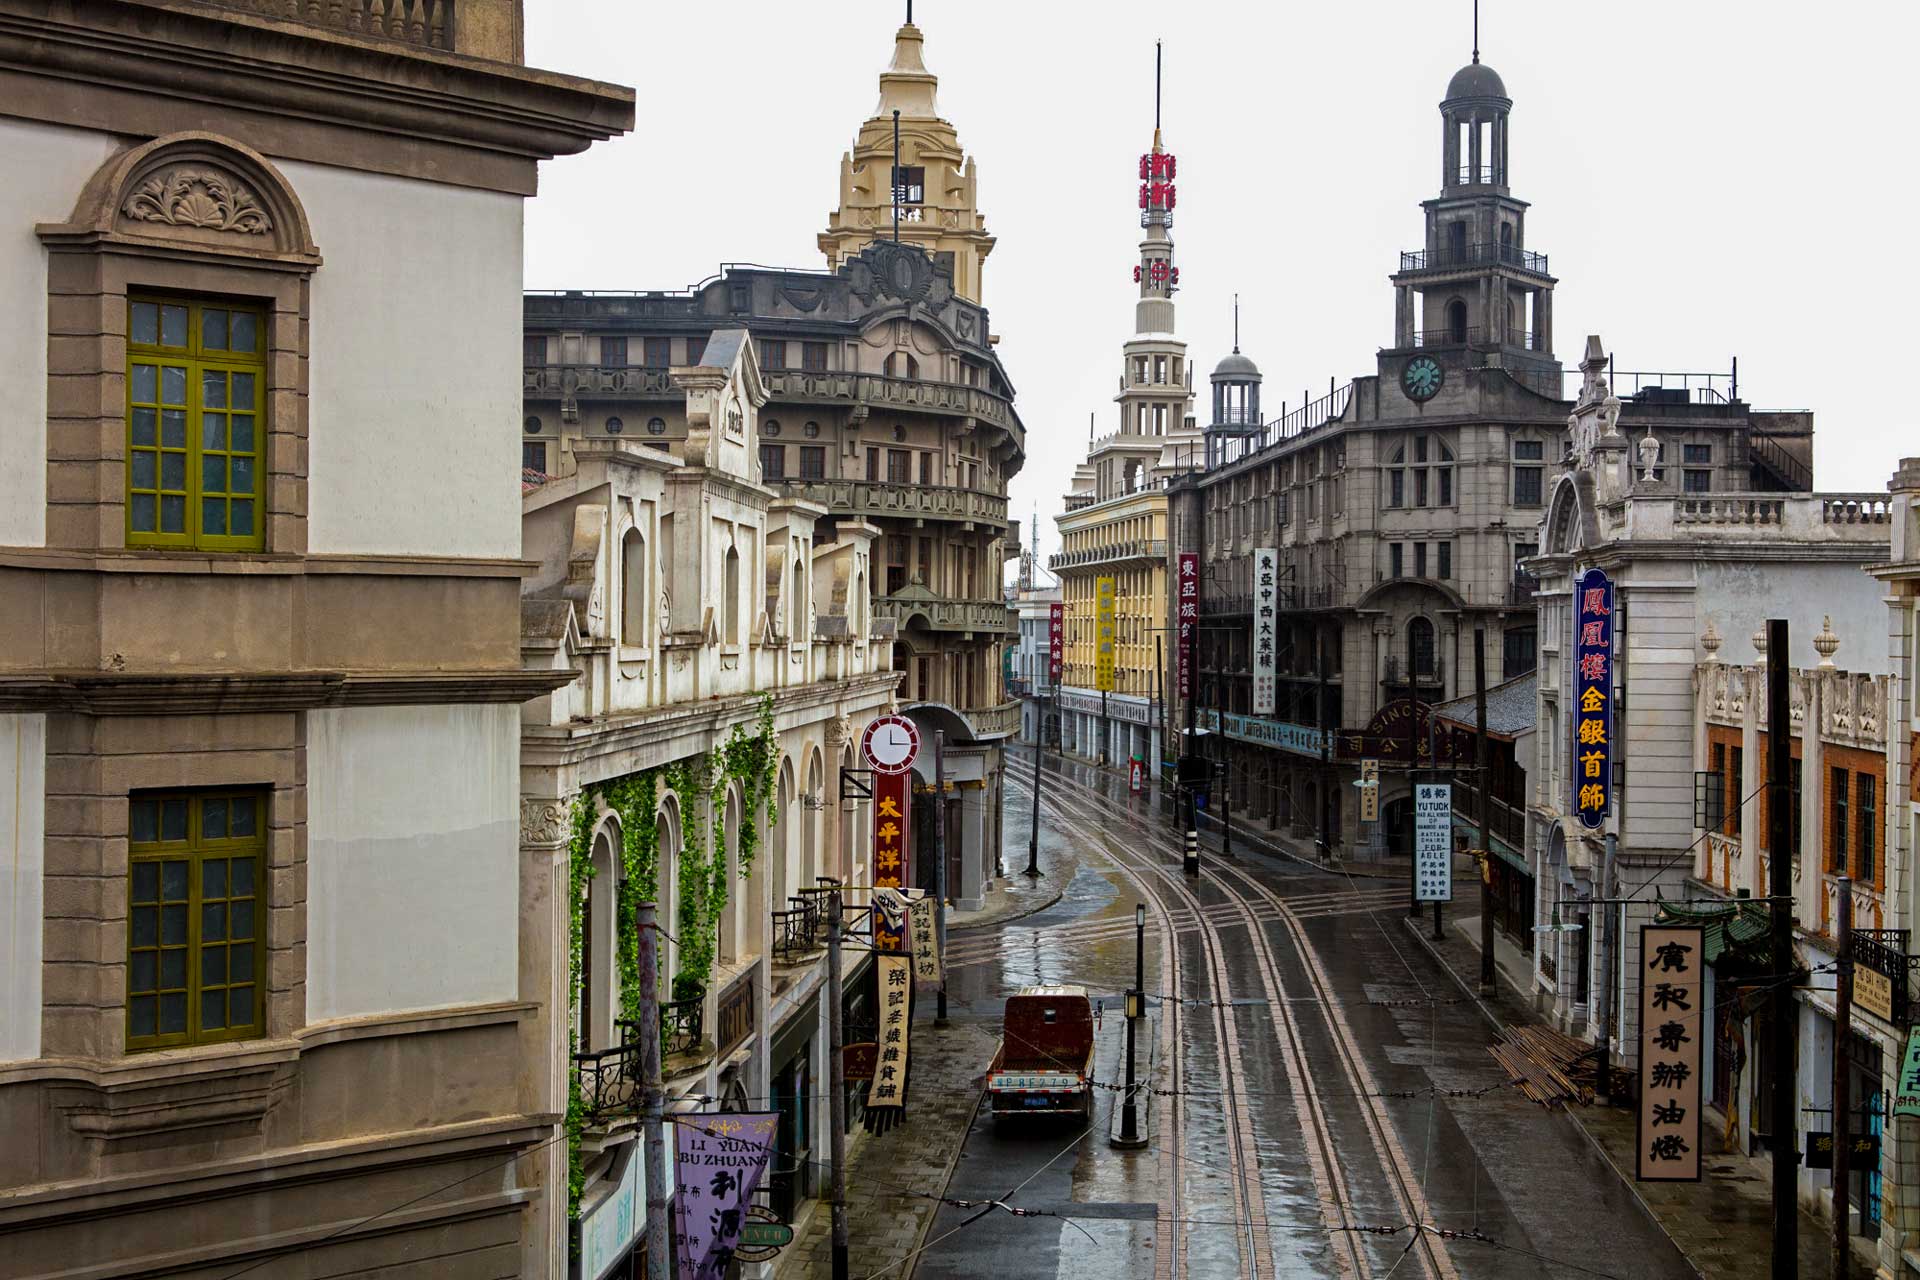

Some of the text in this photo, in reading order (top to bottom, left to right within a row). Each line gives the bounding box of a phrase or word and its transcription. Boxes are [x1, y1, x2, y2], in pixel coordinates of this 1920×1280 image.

[1579, 587, 1610, 811] 鳳凰樓金銀首飾
[876, 796, 902, 951] 太平洋行
[680, 1153, 700, 1165] BU
[691, 1140, 705, 1151] LI
